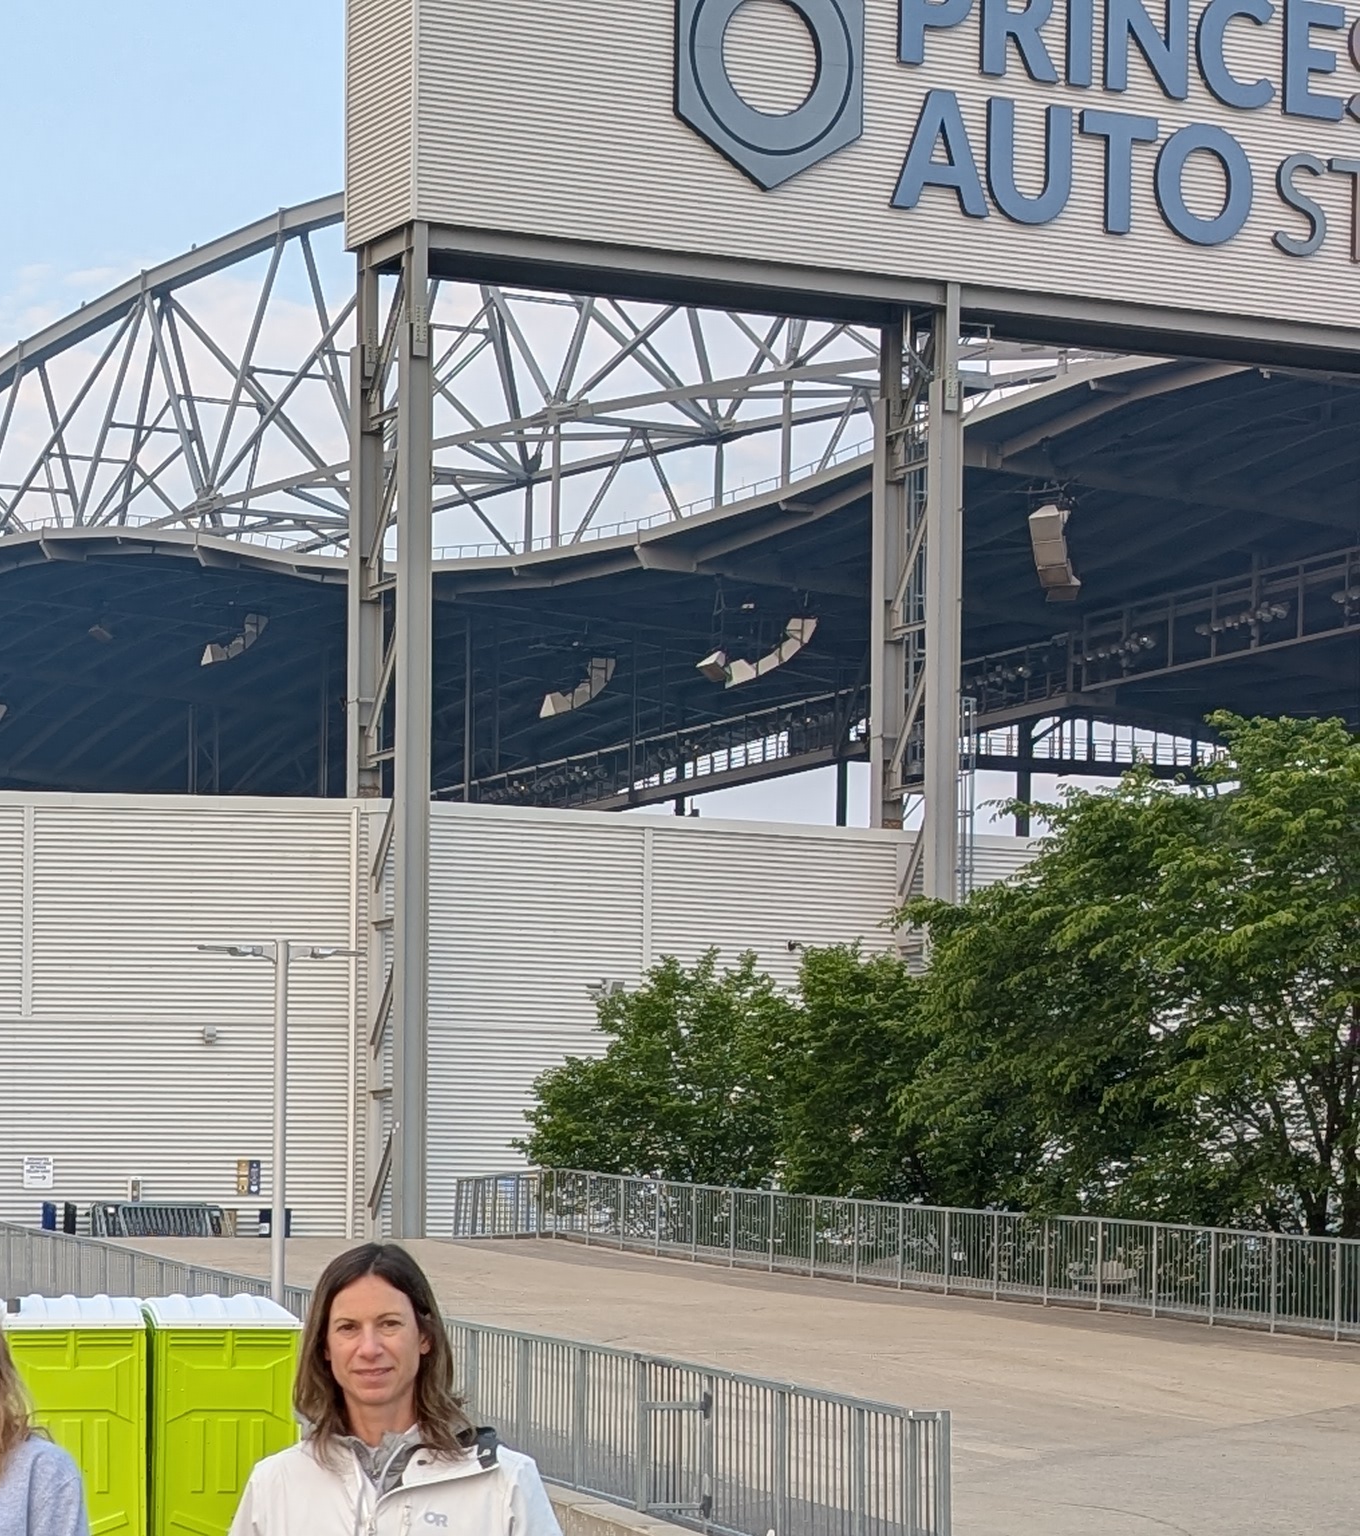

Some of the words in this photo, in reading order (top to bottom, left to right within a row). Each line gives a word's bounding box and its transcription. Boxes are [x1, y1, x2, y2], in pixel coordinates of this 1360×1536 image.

[897, 0, 1360, 122] PRINCE
[889, 90, 1253, 247] AUTO
[424, 1512, 448, 1527] OR
